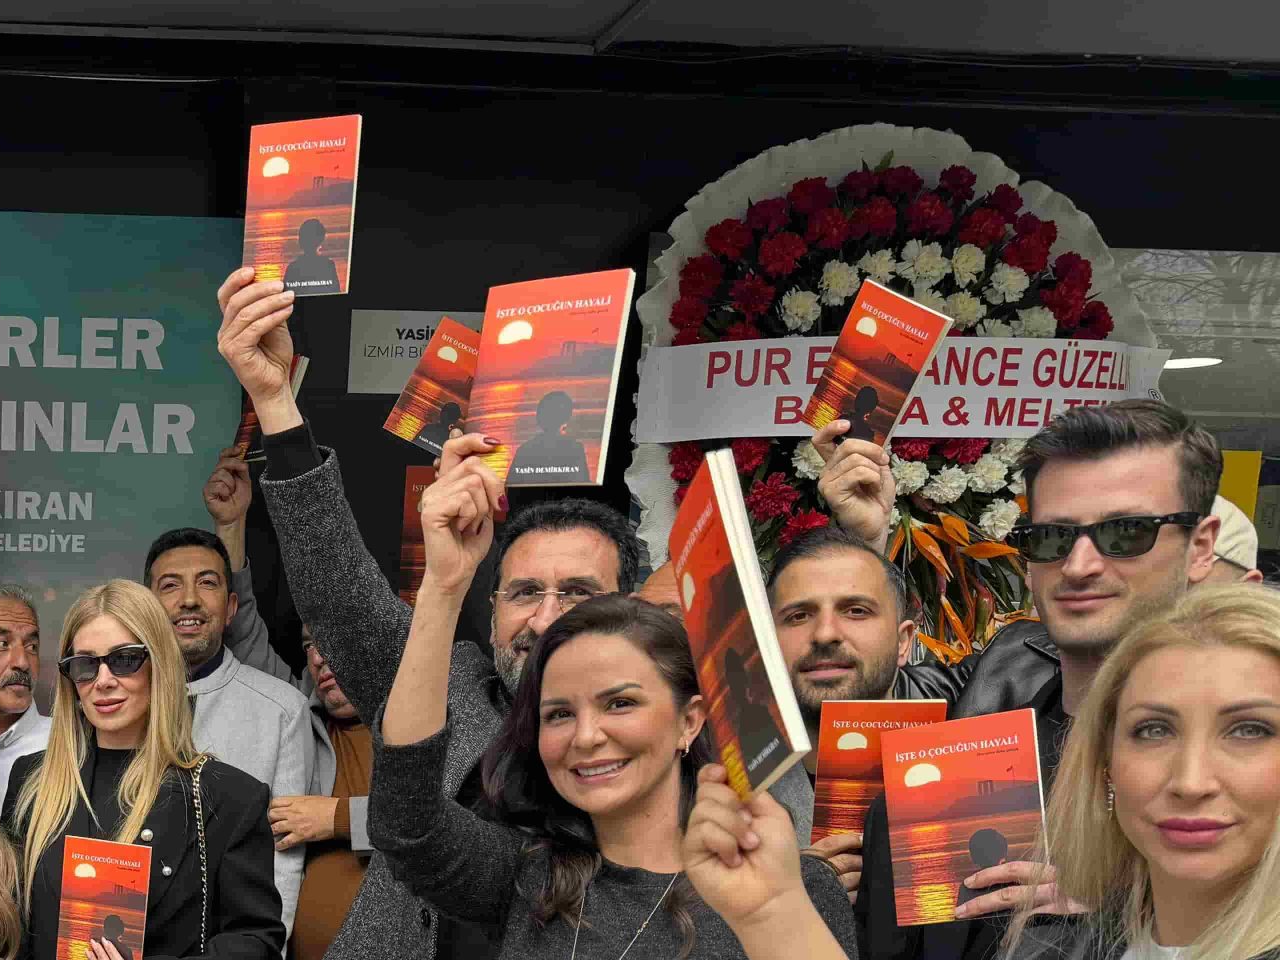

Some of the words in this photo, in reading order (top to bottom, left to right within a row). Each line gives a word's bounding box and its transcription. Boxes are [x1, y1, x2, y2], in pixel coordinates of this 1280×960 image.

[259, 144, 274, 154] İŞTE
[276, 144, 281, 152] O
[283, 140, 319, 153] ÇOCUĞUN
[320, 137, 346, 147] HAYALİ
[496, 308, 516, 319] İŞTE
[518, 307, 525, 315] O
[527, 300, 572, 315] ÇOCUĞUN
[575, 296, 611, 308] HAYALİ
[363, 343, 404, 359] İZMİR
[706, 346, 791, 388] PUR
[943, 396, 970, 426] &
[833, 720, 850, 729] İŞTE
[861, 720, 901, 730] ÇOCUĞUN
[895, 751, 917, 763] İŞTE
[919, 750, 926, 758] O
[928, 741, 978, 759] ÇOCUĞUN
[980, 735, 1018, 749] HAYALİ
[72, 852, 84, 861] İŞTE
[91, 855, 119, 864] ÇOCUĞUN
[120, 859, 141, 868] HAYALİ
